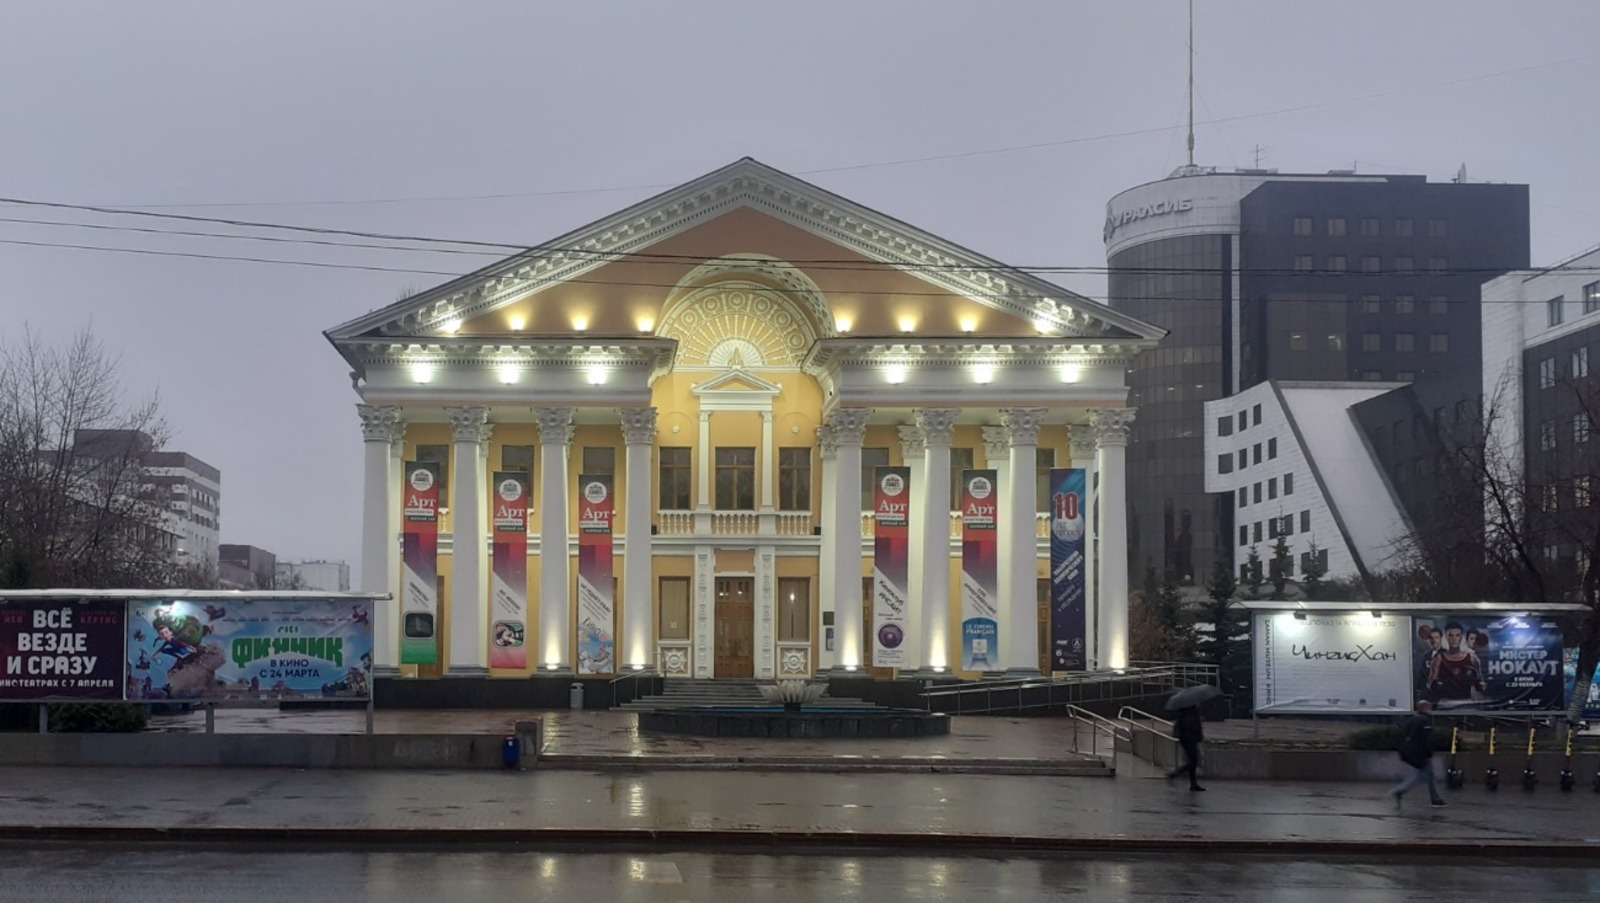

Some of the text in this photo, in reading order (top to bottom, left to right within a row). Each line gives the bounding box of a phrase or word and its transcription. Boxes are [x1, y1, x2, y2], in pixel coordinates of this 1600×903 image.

[408, 494, 437, 510] Арт
[879, 499, 907, 514] Арт
[967, 502, 995, 517] Арт
[1053, 492, 1078, 520] 10
[496, 504, 525, 519] Арт
[582, 507, 611, 521] Арт
[33, 607, 72, 628] ВСЁ
[18, 633, 87, 654] ВЕЗДЕ
[232, 637, 343, 668] ФИННИК
[1499, 650, 1548, 660] МИСТЕР
[7, 656, 97, 675] И СРАЗУ
[270, 659, 309, 667] В КИНО
[1488, 660, 1558, 675] НОКАУТ
[259, 669, 320, 678] С 24 МАРТА
[61, 679, 68, 687] С
[70, 679, 75, 687] 7
[78, 679, 114, 687] АПРЕЛЯ
